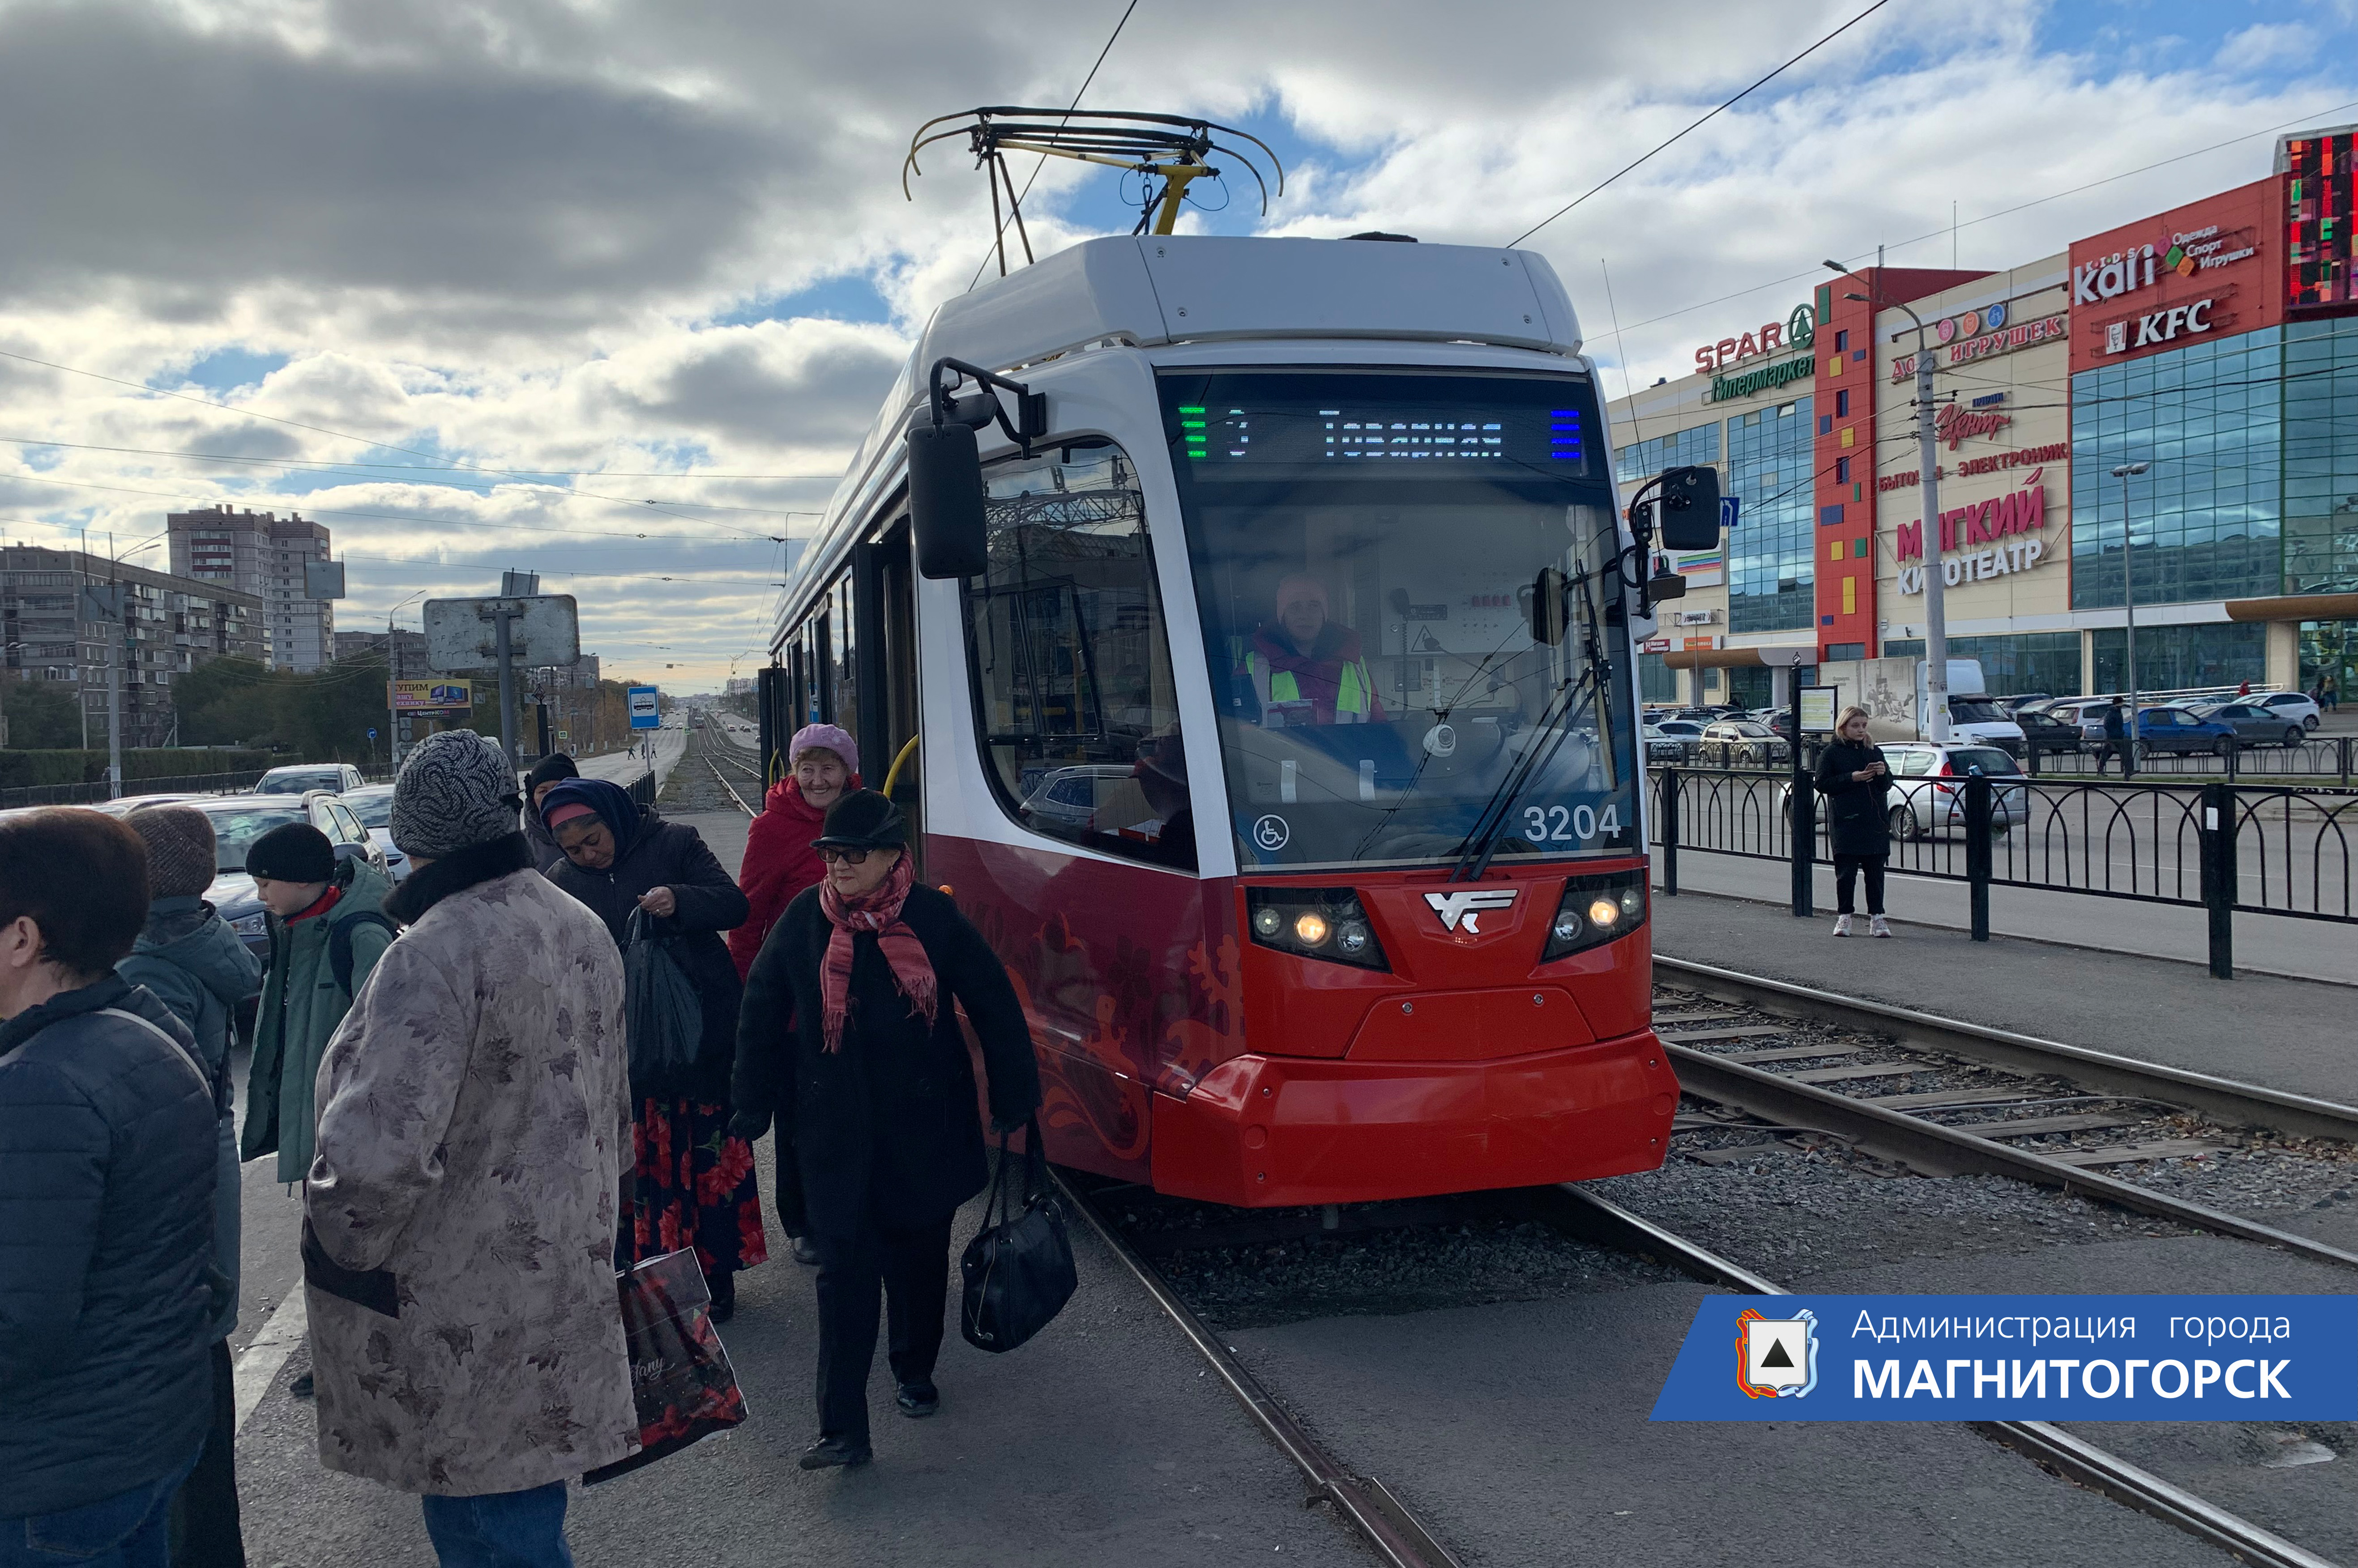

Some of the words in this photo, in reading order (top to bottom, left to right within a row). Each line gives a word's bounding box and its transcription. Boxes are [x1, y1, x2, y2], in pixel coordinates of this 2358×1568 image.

[2172, 225, 2217, 245] Одежда
[2185, 239, 2223, 257] Спорт
[2200, 247, 2253, 269] Игрушки
[2074, 244, 2154, 306] kari
[2135, 299, 2212, 346] KFC
[1695, 322, 1781, 373] SPAR
[1892, 356, 1915, 378] ДО
[1950, 316, 2060, 362] ИГРУШЕК
[1711, 354, 1815, 402] Гипермаркет
[1320, 410, 1501, 458] Товарная
[1958, 443, 2068, 477] ЭЛЕКТРОНИК
[1897, 539, 2042, 596] КИОТЕАТР
[396, 683, 428, 691] УПИМ
[1524, 804, 1621, 841] 3204
